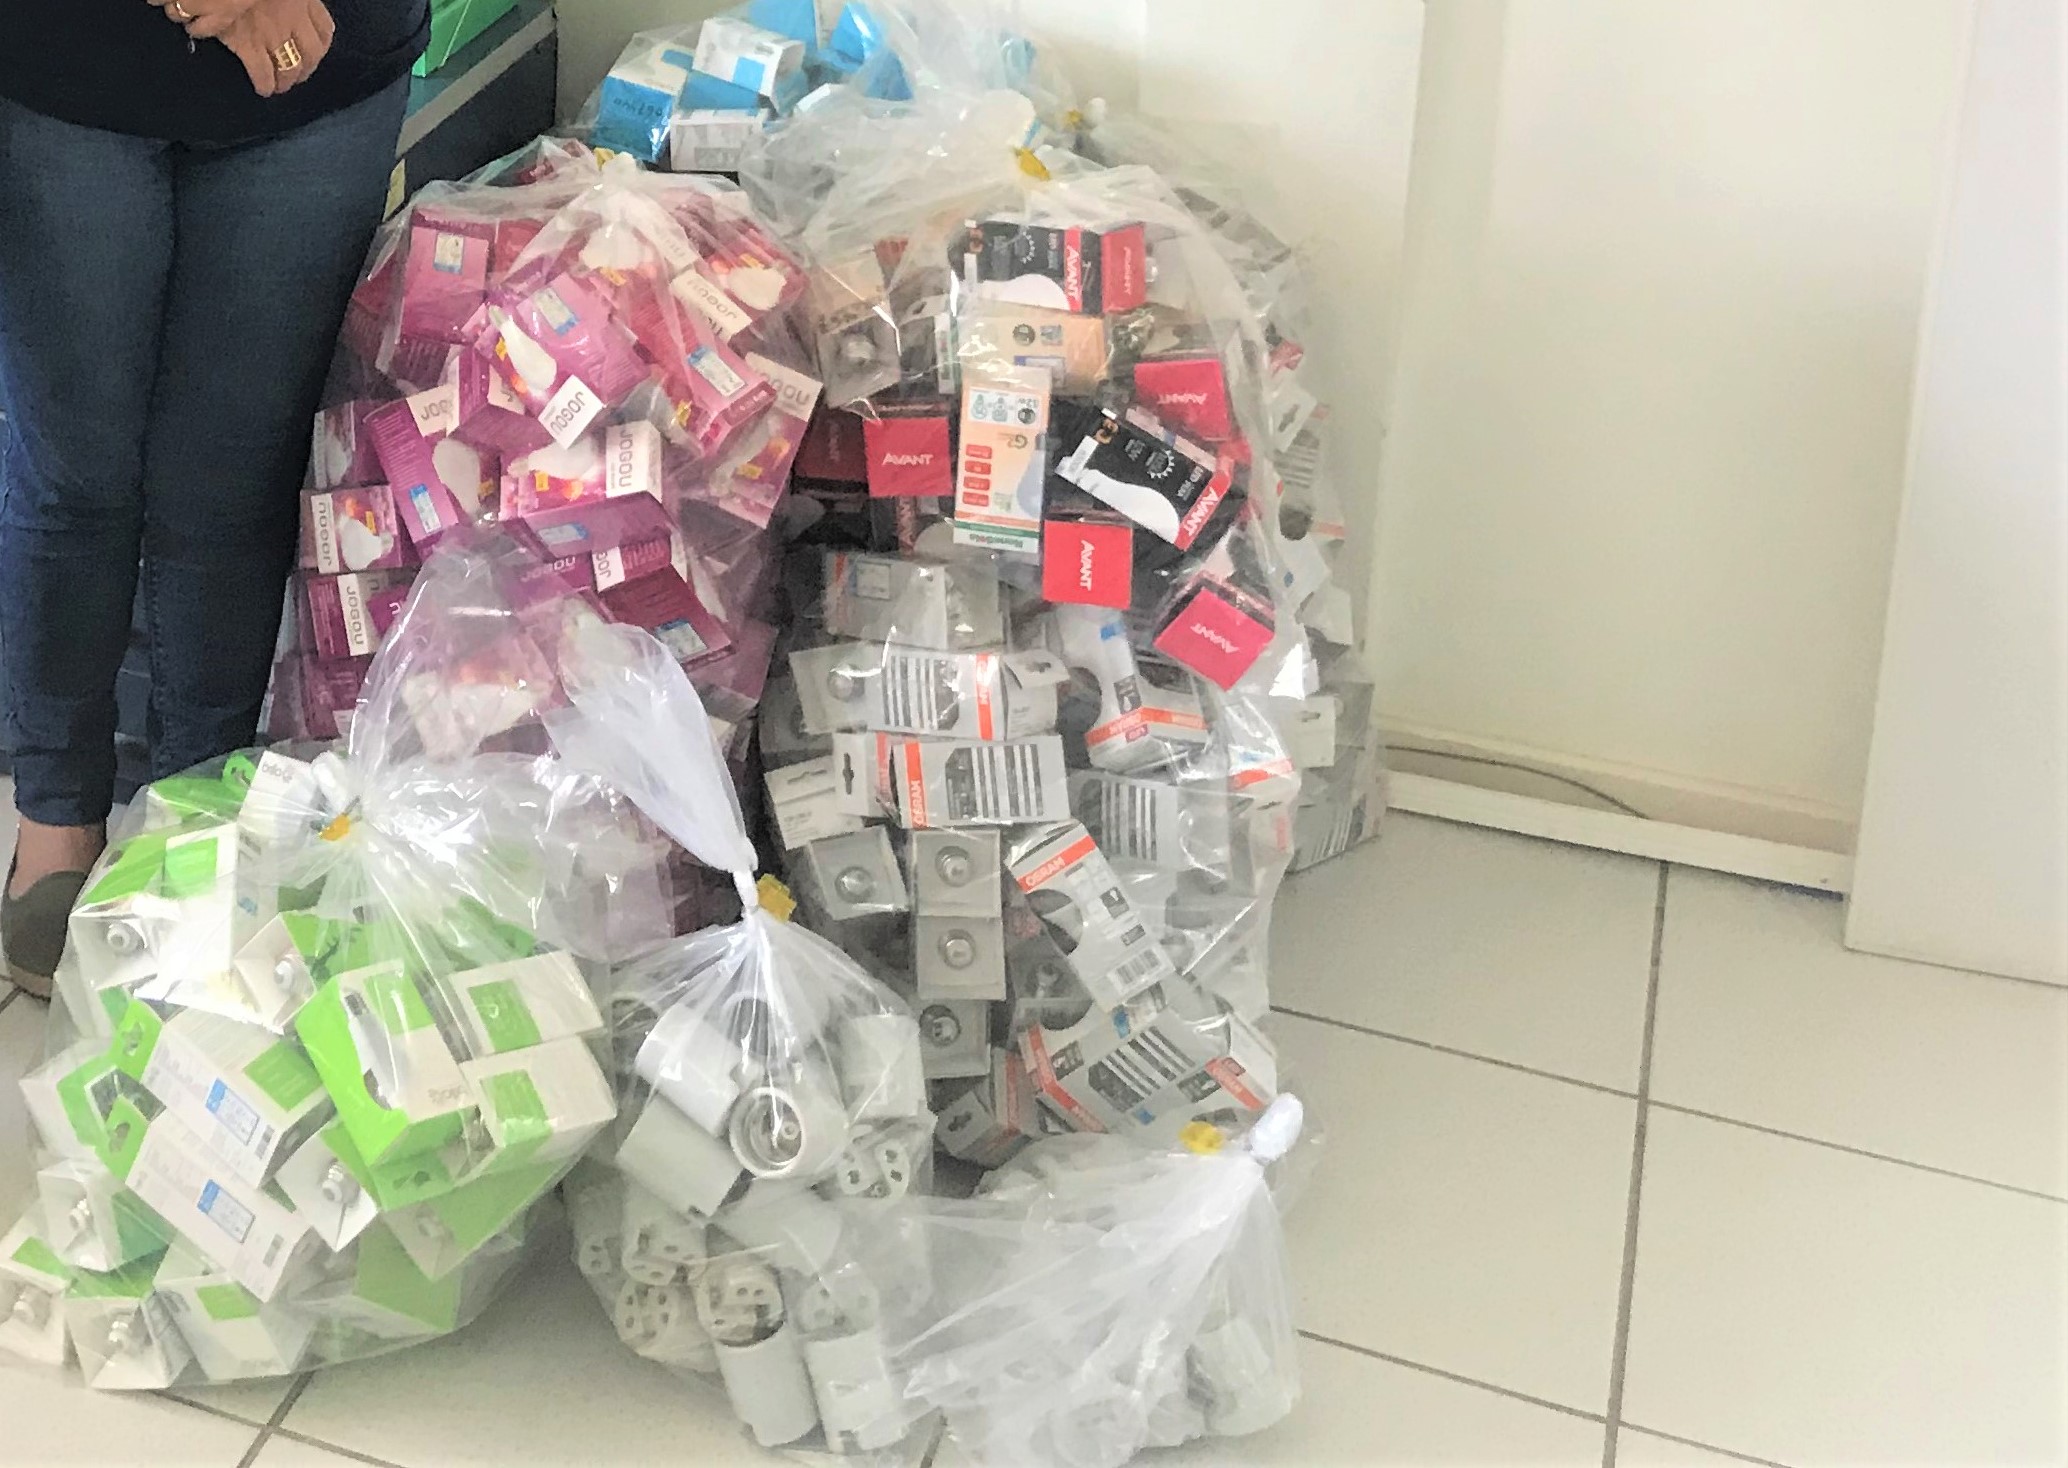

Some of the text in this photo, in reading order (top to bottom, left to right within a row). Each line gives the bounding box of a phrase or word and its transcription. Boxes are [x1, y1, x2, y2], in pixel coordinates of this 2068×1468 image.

[1066, 244, 1080, 301] AVANT
[421, 397, 453, 421] JOG
[549, 390, 585, 435] JOGOU
[1158, 392, 1207, 405] AVANT
[617, 428, 633, 488] JOGOU
[882, 453, 933, 466] AVANT
[318, 501, 332, 567] JOGOU
[1180, 486, 1219, 536] AVANT
[1080, 540, 1095, 591] AVANT
[346, 585, 365, 645] JOGOU
[1190, 622, 1239, 654] AVANT
[908, 779, 925, 827] OSRAM
[1026, 856, 1065, 887] OSRAM
